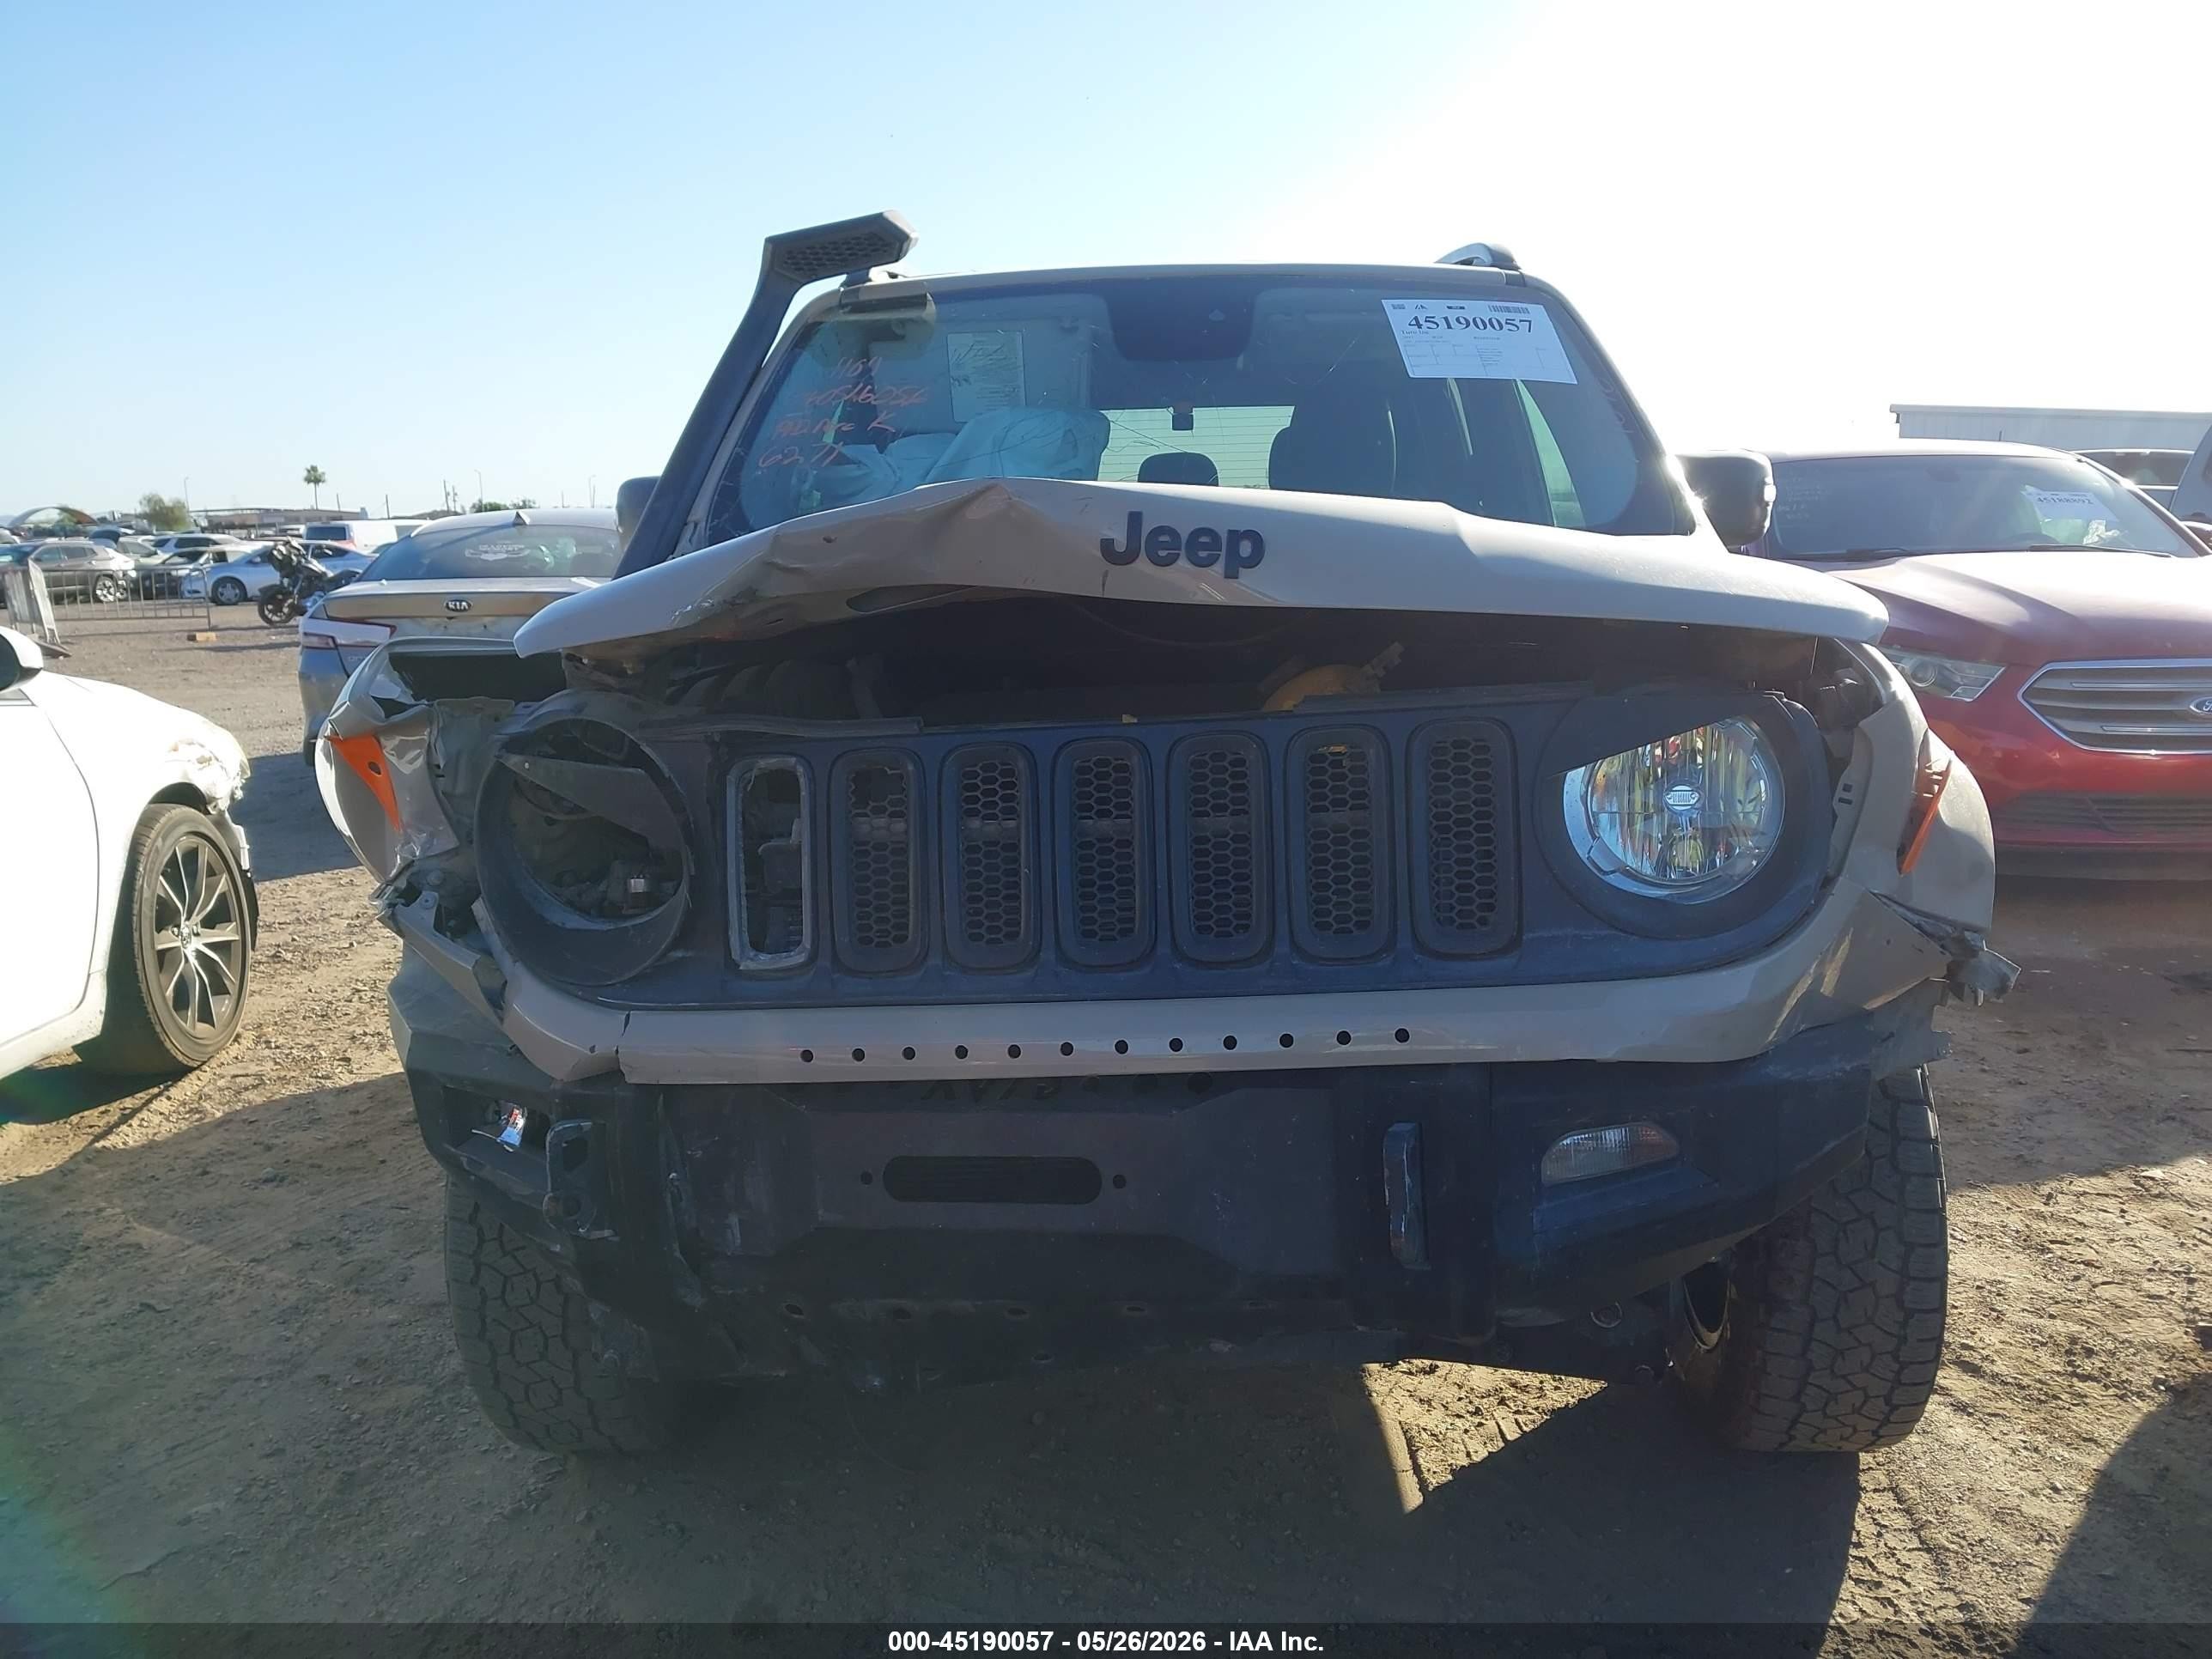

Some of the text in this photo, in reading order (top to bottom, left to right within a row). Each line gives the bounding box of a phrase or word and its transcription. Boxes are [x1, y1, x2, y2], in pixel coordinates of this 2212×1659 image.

[1407, 314, 1533, 333] 45190057
[1100, 511, 1266, 579] Jeep
[447, 600, 469, 611] KIA
